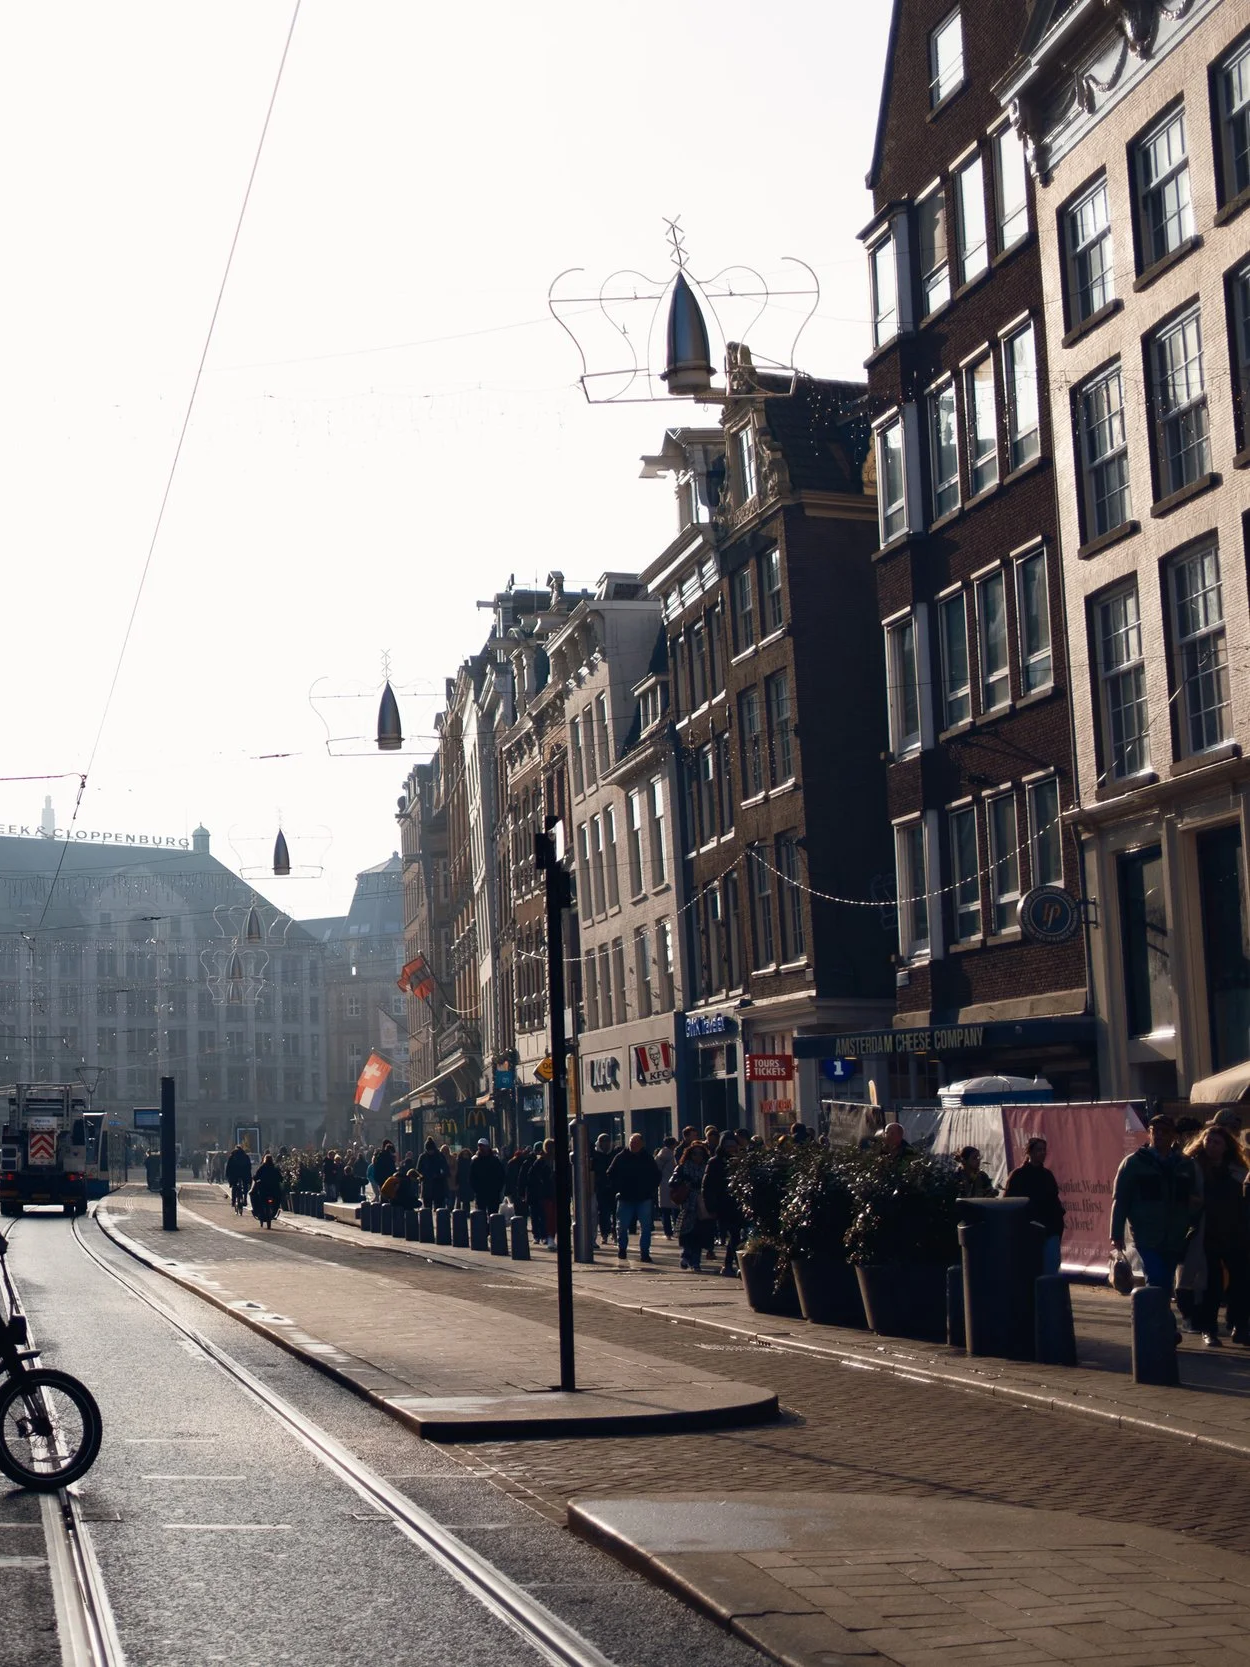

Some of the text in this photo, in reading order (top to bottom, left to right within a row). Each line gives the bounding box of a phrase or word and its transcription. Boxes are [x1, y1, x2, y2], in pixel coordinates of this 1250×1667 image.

[35, 825, 49, 838] &
[52, 827, 190, 848] CLOPPENBURG
[835, 1027, 984, 1057] AMSTERDAM CHEESE COMPANY
[593, 1056, 613, 1087] KFC
[753, 1059, 780, 1067] TOURS
[753, 1067, 786, 1076] TICKETS
[649, 1070, 670, 1081] KFC
